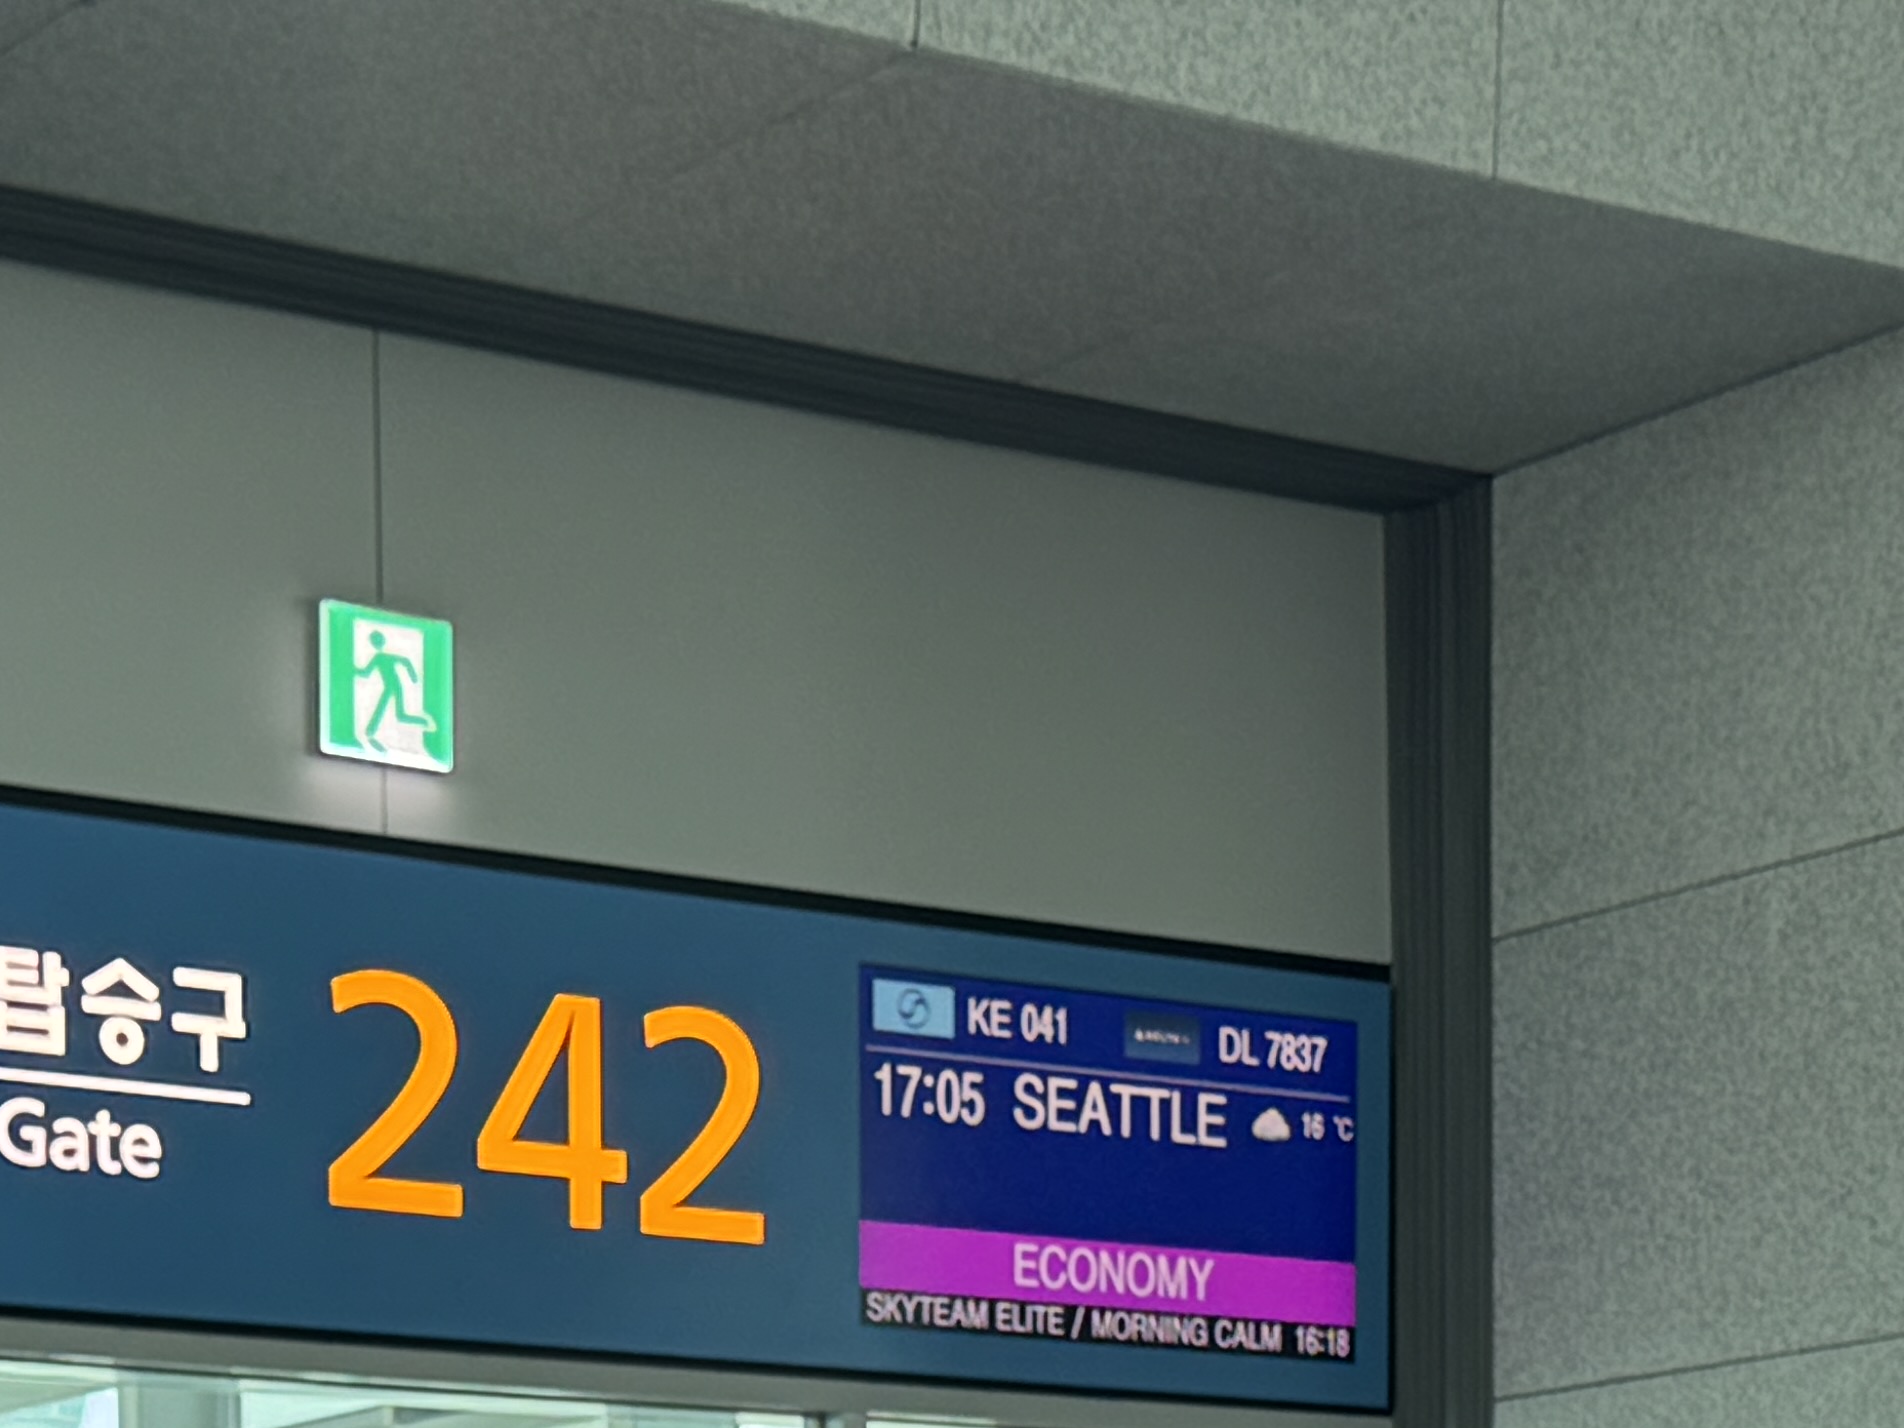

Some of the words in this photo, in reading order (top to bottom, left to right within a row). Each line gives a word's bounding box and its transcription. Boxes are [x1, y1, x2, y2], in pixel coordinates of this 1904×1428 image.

[967, 997, 1012, 1038] KE
[1021, 1003, 1067, 1046] 041
[1218, 1025, 1259, 1068] DL
[1265, 1030, 1328, 1073] 7837
[327, 968, 766, 1245] 242
[873, 1062, 986, 1127] 17:05
[1013, 1073, 1227, 1148] SEATTLE
[1013, 1242, 1214, 1302] ECONOMY
[867, 1292, 989, 1331] SKYTEAM
[996, 1303, 1064, 1337] ELITE
[1092, 1309, 1208, 1347] MORNING
[1215, 1320, 1281, 1351] CALM
